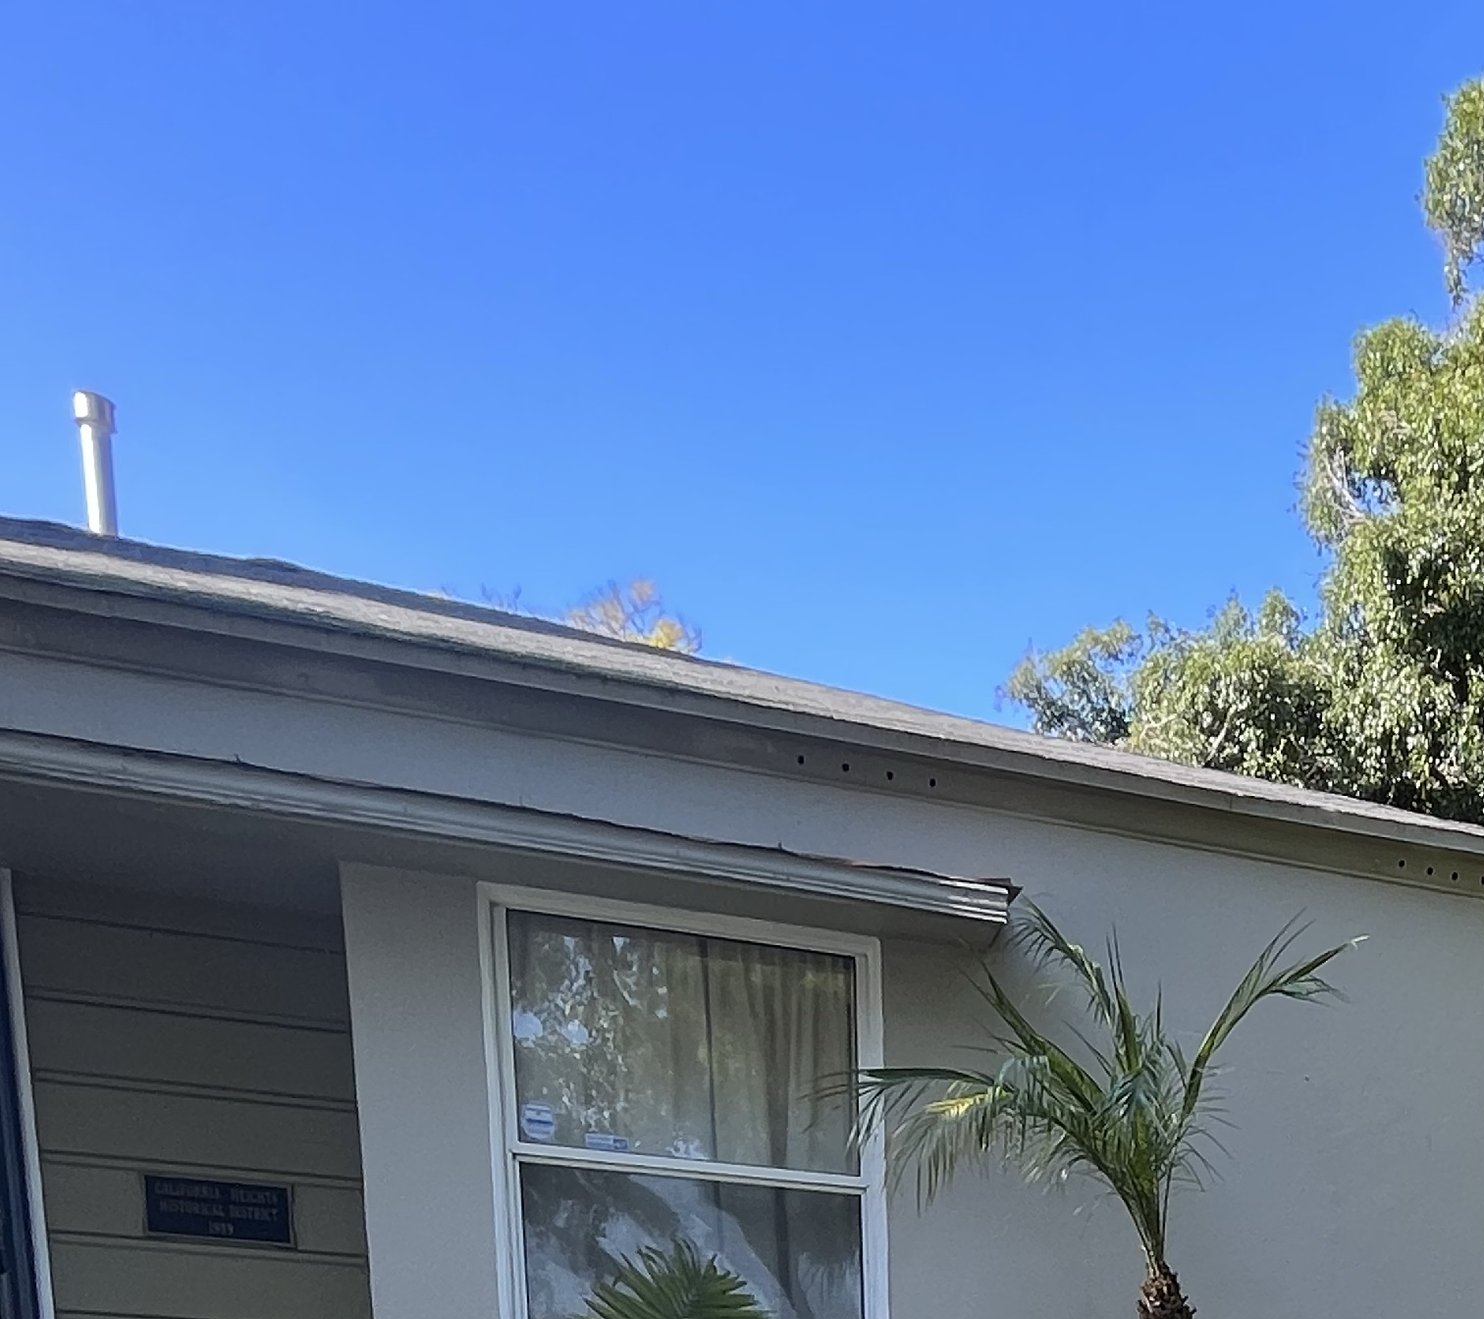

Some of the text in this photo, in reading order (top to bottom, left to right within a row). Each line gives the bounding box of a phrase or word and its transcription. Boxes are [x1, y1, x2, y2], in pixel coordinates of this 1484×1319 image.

[154, 1182, 220, 1199] CALIFORNIA
[159, 1199, 279, 1222] HISTORICAL DISTRICT
